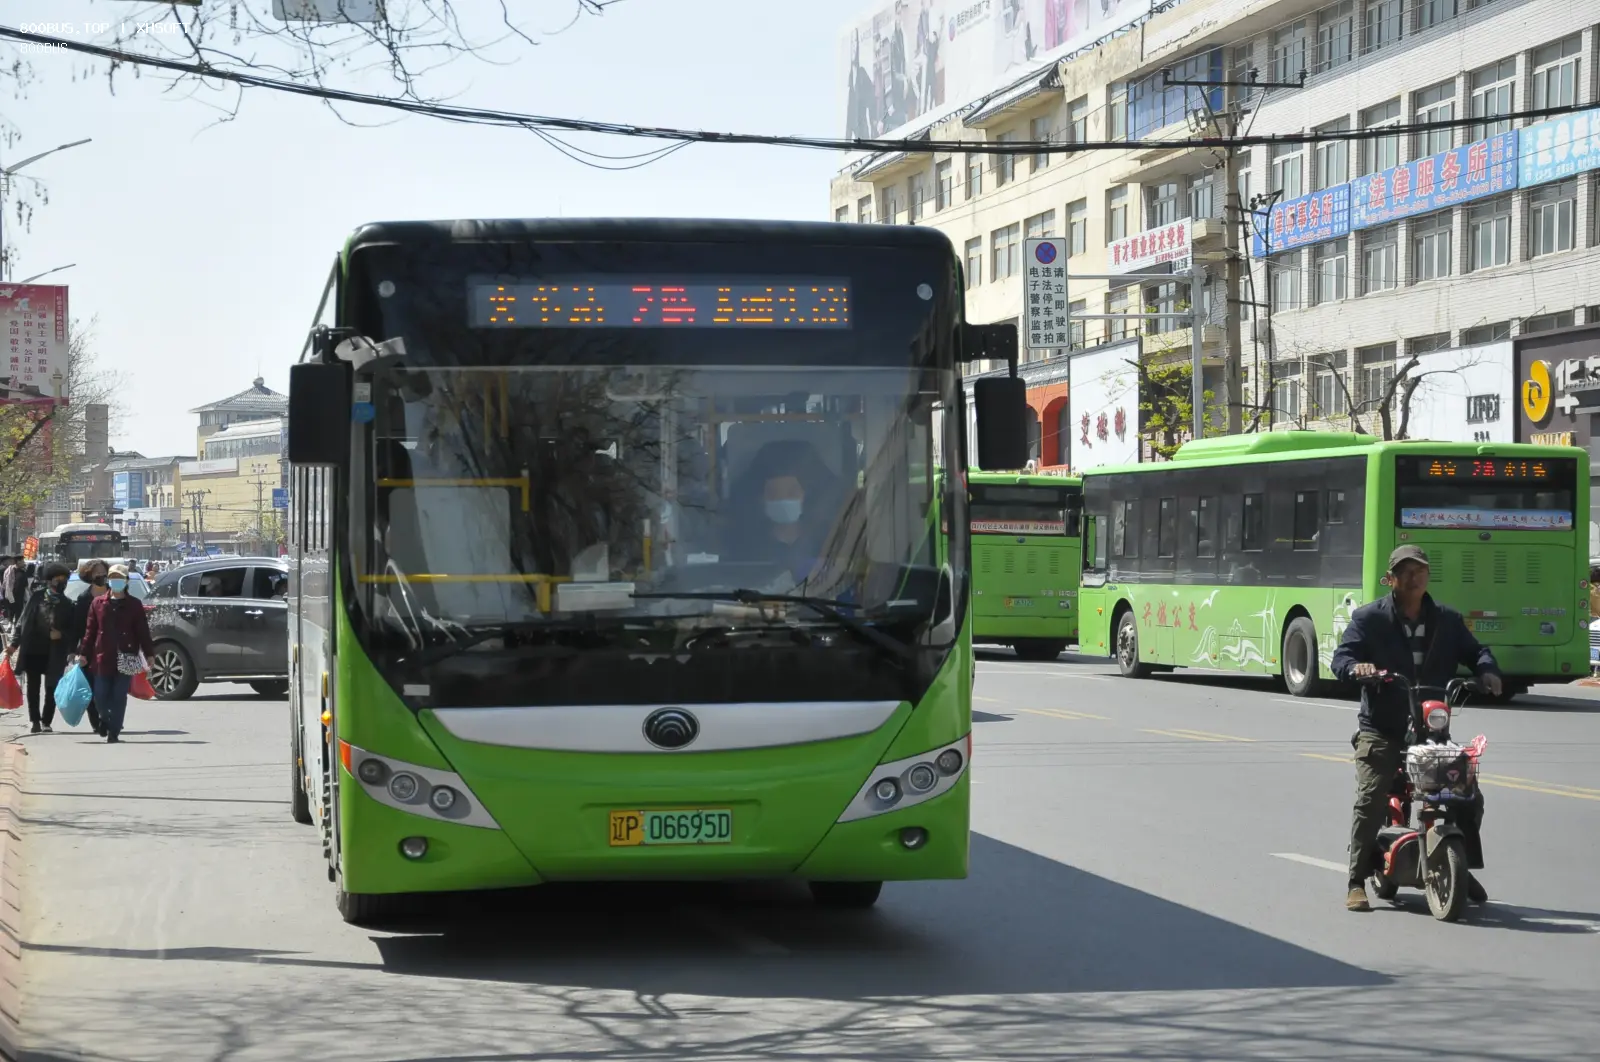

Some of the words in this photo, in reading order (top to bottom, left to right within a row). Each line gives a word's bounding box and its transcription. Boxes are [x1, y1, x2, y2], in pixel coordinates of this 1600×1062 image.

[1368, 143, 1488, 209] 法律服务所
[1274, 193, 1333, 237] 律师事务所
[1029, 266, 1042, 344] 电子警察监管
[1041, 267, 1054, 344] 违法停车抓拍
[1053, 267, 1066, 343] 请立即驶离
[612, 816, 639, 841] 辽P
[650, 813, 730, 840] 06695D
